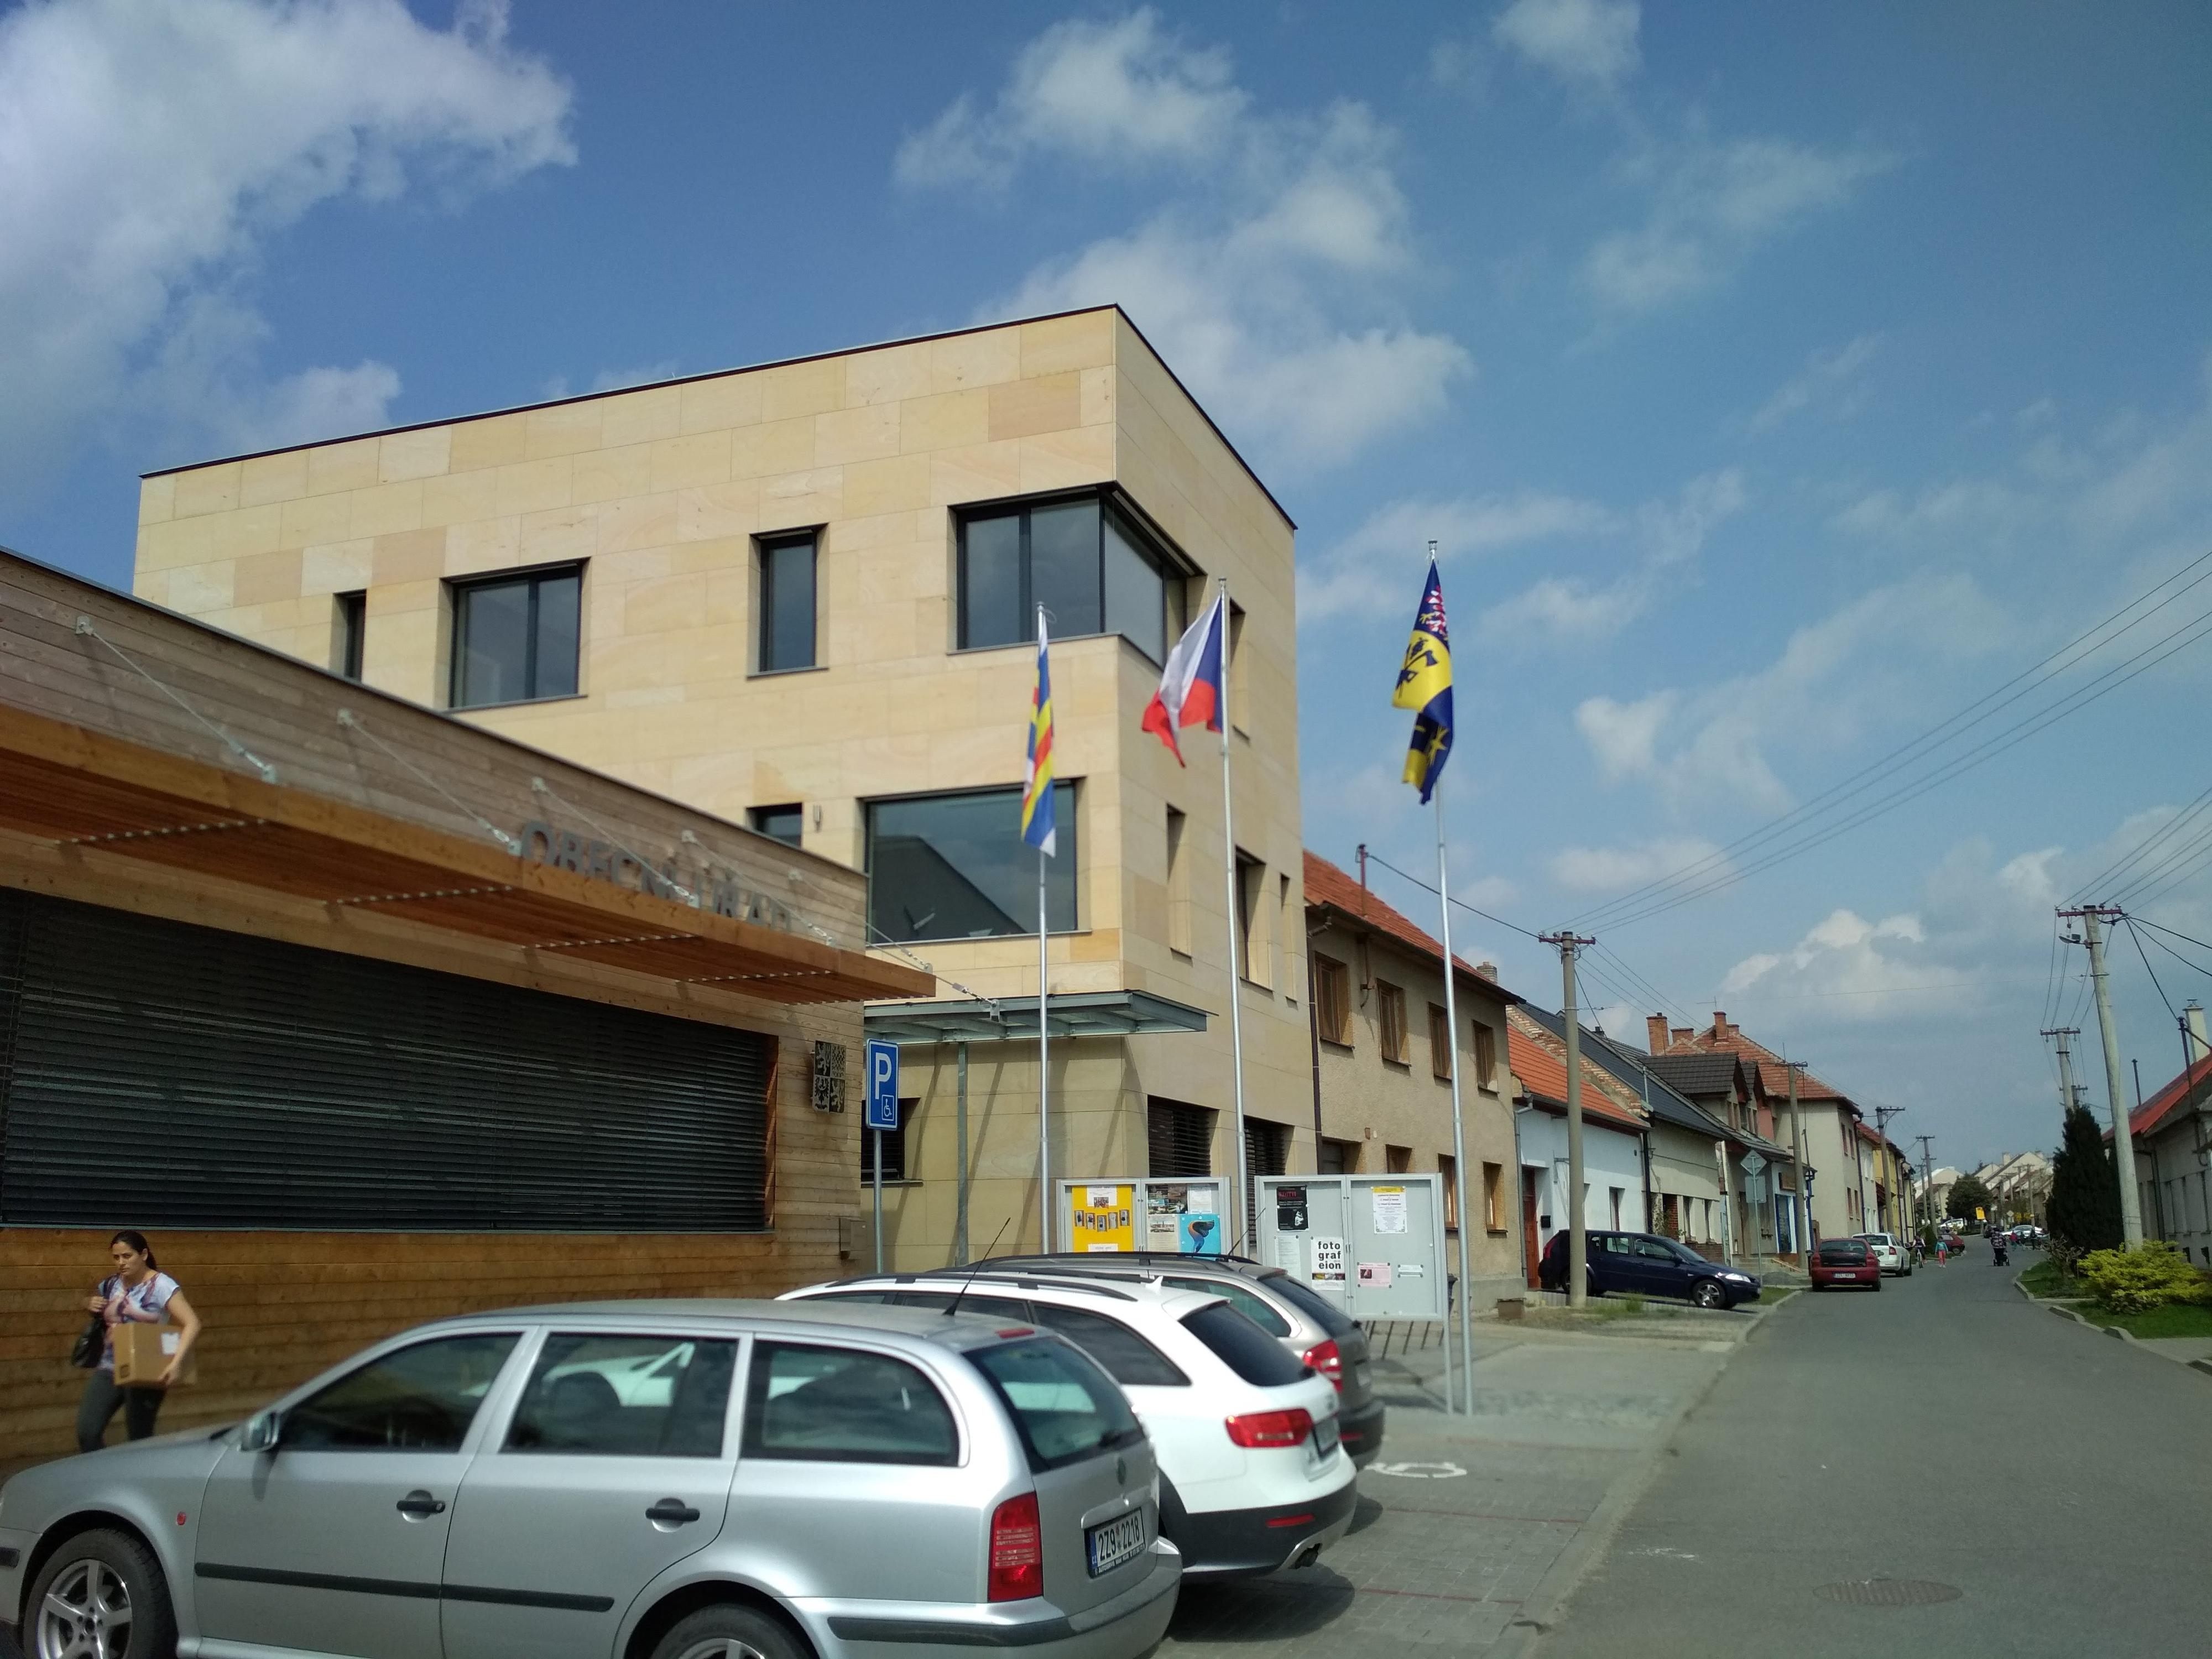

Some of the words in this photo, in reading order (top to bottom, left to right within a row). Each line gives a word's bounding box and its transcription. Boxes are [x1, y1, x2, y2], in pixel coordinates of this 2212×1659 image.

[875, 1052, 891, 1099] P
[1318, 1241, 1340, 1249] foto
[1318, 1251, 1341, 1261] graf
[1318, 1260, 1341, 1269] eion
[1098, 1528, 1116, 1561] 2Z9
[1121, 1516, 1140, 1549] 2218
